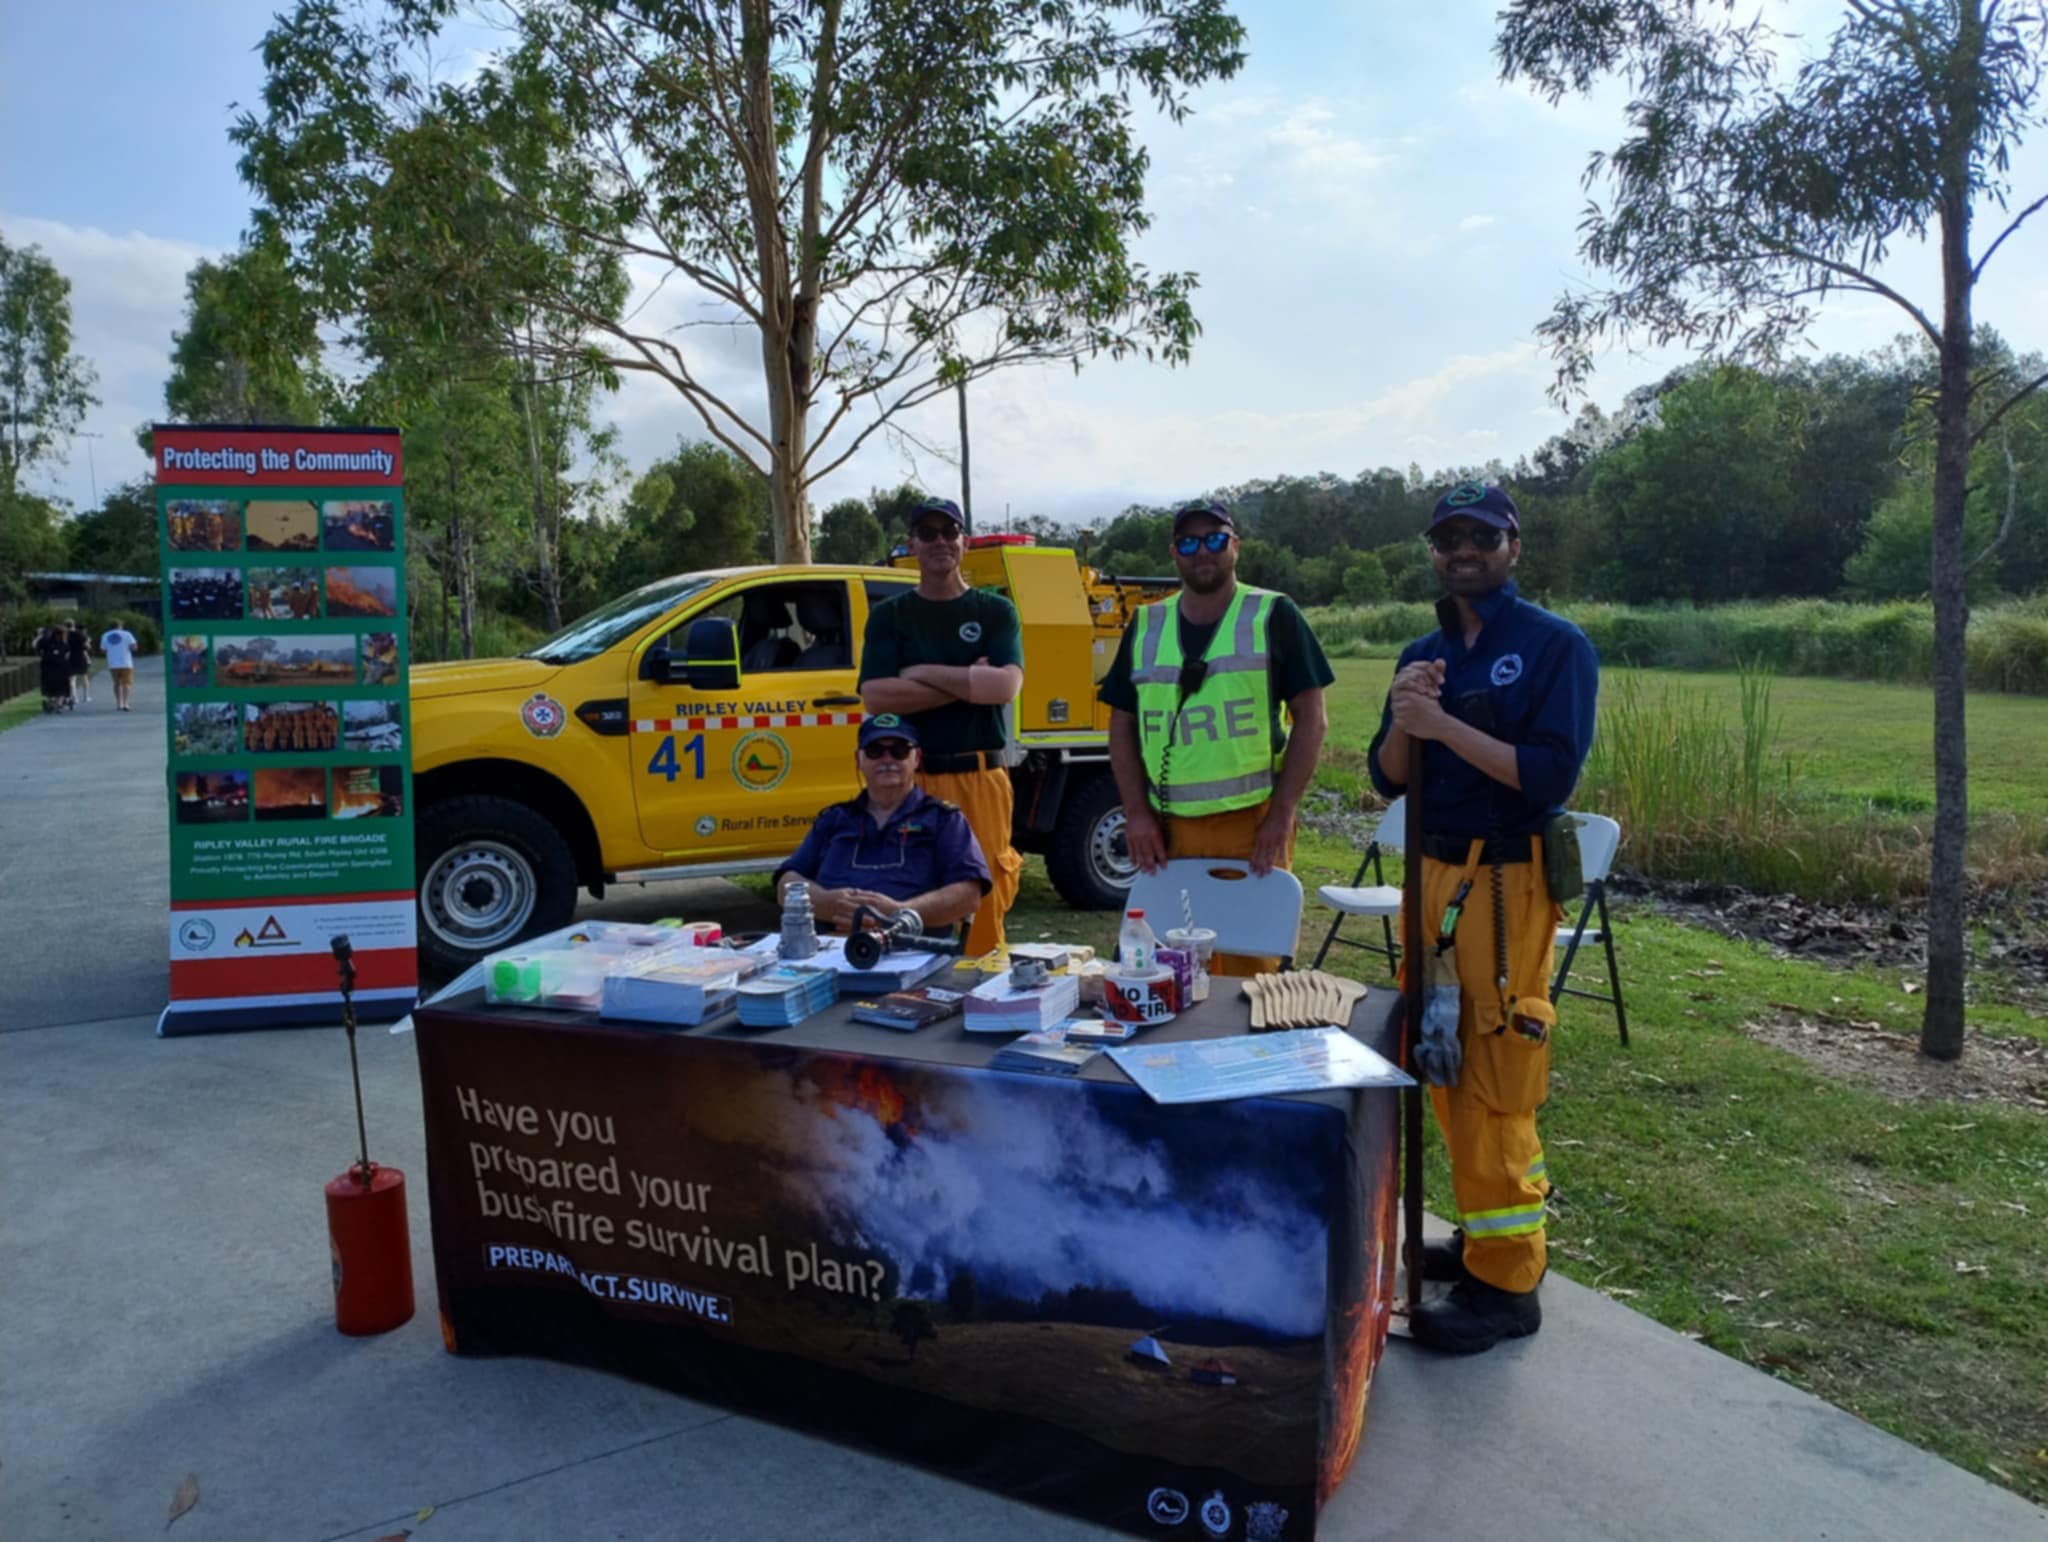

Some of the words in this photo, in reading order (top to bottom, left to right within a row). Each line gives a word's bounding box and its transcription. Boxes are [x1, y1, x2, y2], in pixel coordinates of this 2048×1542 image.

[163, 446, 257, 475] Protecting
[261, 448, 291, 472] the
[294, 448, 394, 476] Community
[675, 701, 738, 717] RIPLEY
[743, 699, 808, 715] VALLEY
[1143, 697, 1260, 747] FIRE
[647, 733, 706, 783] 41
[193, 839, 232, 850] RIPLEY
[234, 837, 275, 849] VALLEY
[276, 836, 312, 847] RURAL
[314, 834, 338, 845] FIRE
[340, 833, 387, 845] BRIGADE
[721, 817, 754, 833] Rural
[757, 815, 780, 830] Fire
[456, 1084, 541, 1137] Have
[546, 1107, 618, 1149] you
[469, 1141, 623, 1196] prepared
[630, 1169, 713, 1214] your
[626, 1218, 774, 1279] survival
[784, 1242, 887, 1303] plan?
